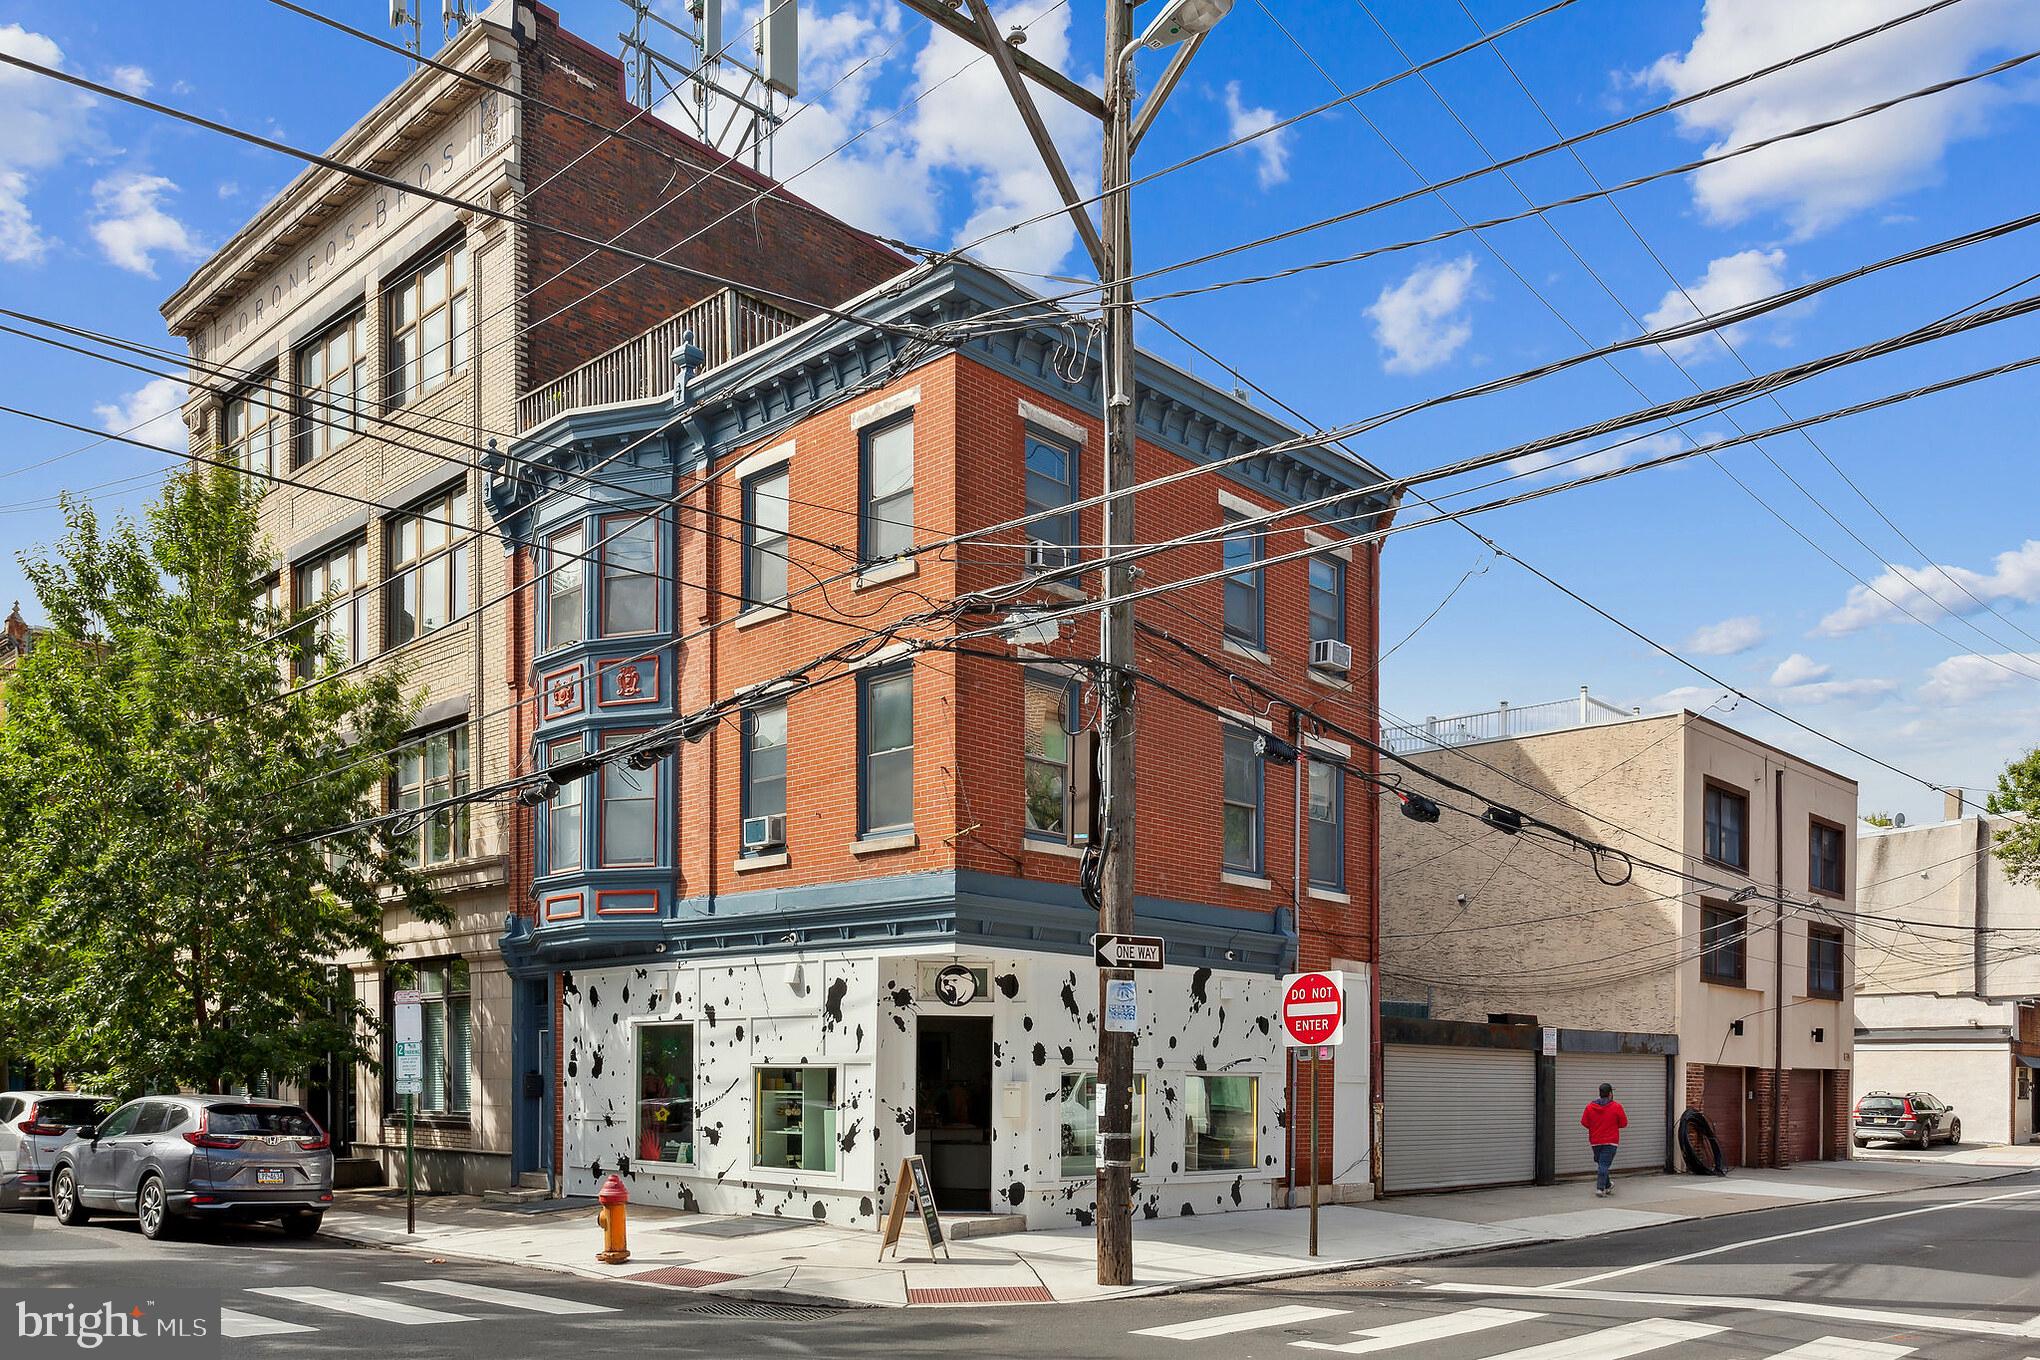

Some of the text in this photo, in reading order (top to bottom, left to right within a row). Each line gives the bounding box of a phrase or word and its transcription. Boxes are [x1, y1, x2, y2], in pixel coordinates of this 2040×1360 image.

[1116, 945, 1157, 960] ONE WAY
[1291, 986, 1333, 1000] DO NOT
[1295, 1018, 1329, 1031] ENTER
[398, 1044, 404, 1056] 2
